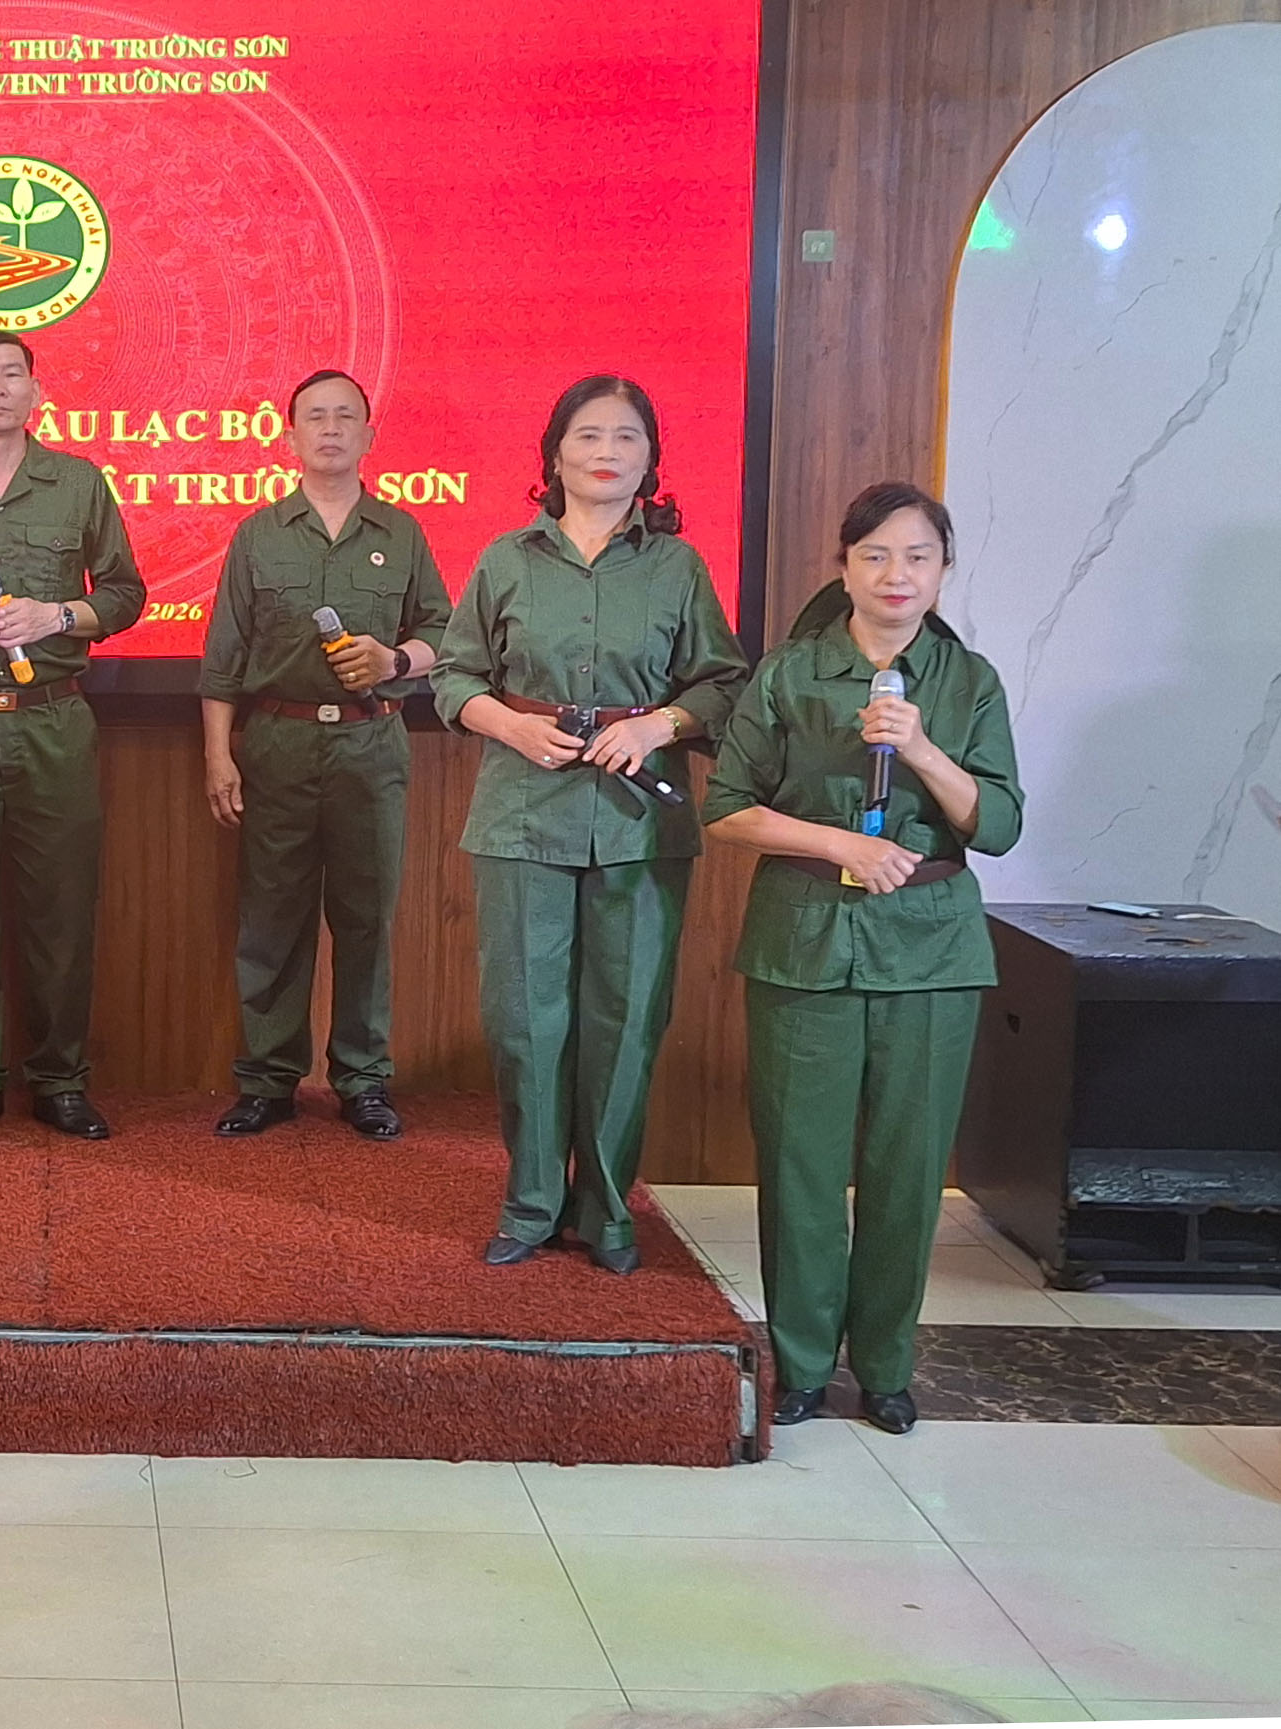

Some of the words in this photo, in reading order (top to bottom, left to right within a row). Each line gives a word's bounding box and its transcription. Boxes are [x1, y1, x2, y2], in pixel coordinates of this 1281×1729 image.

[10, 34, 104, 63] THUẬT
[111, 33, 227, 60] TRƯỜNG
[234, 35, 289, 58] SƠN
[77, 67, 203, 95] TRƯỜNG
[210, 68, 268, 93] SƠN
[37, 293, 78, 322] SƠN
[29, 401, 98, 442] ÂU
[110, 410, 207, 448] LẠC
[219, 400, 284, 448] BỘ
[169, 464, 303, 505] TRƯỜ
[377, 468, 469, 505] SƠN
[145, 602, 203, 621] 2026
